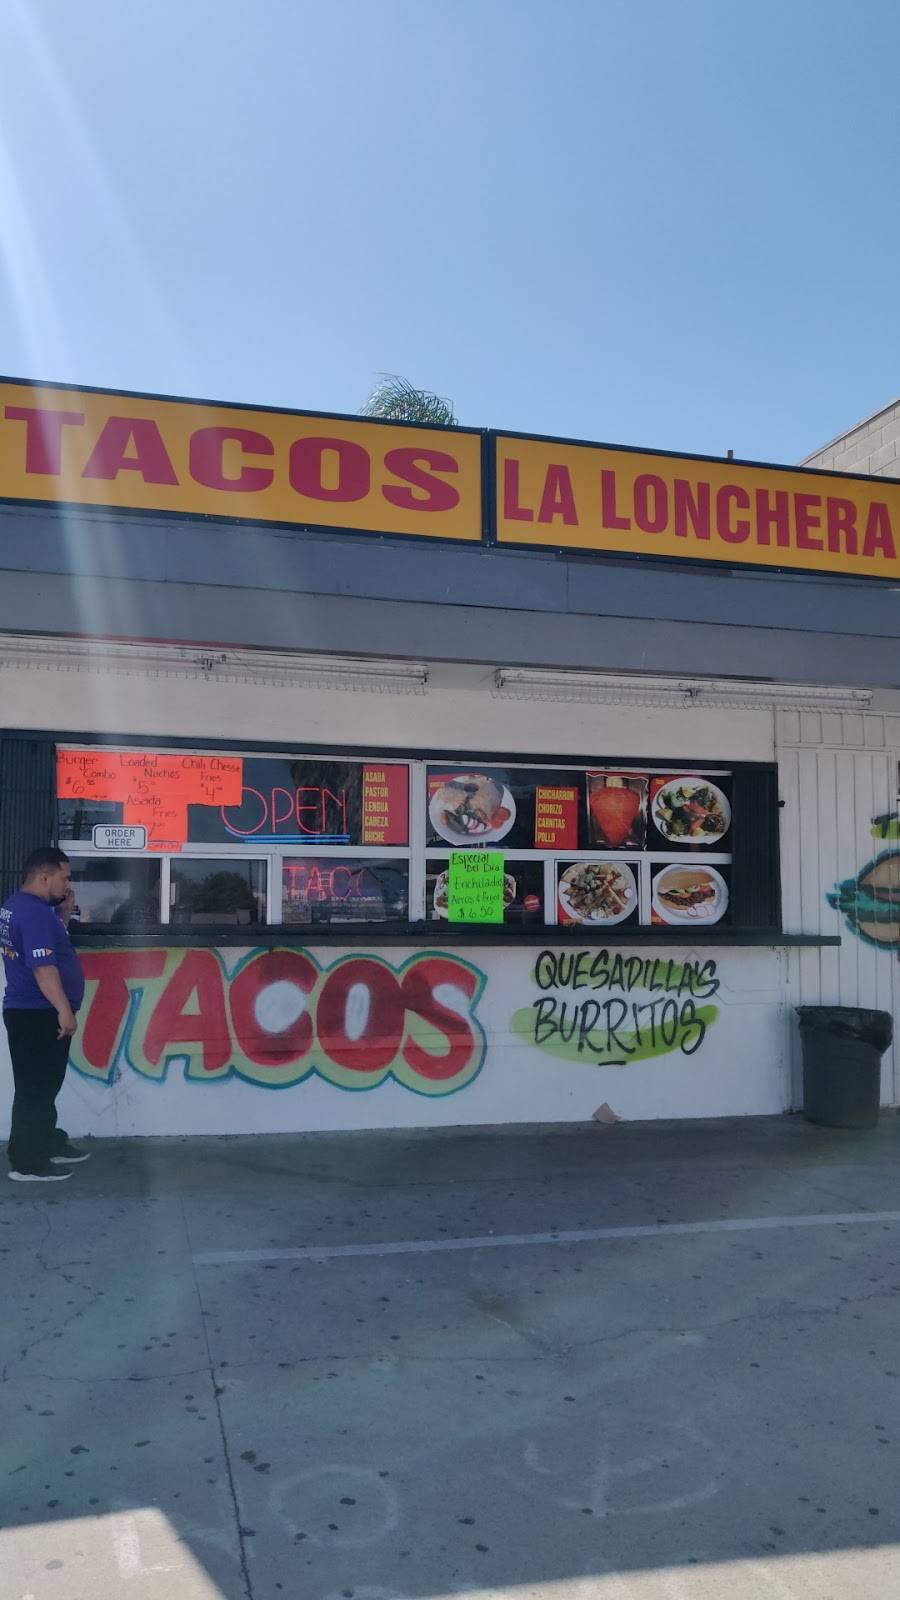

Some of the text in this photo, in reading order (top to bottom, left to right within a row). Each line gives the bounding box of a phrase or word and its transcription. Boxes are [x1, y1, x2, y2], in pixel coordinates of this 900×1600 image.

[5, 405, 460, 512] TACOS
[503, 458, 898, 560] LA LONCHERA
[56, 752, 97, 771] Burger
[120, 754, 158, 768] Loaded
[182, 757, 206, 770] Chili
[83, 768, 116, 780] Combo
[144, 768, 180, 779] Nachos
[365, 771, 386, 783] ASADA
[365, 786, 389, 798] PASTOR
[538, 789, 575, 801] CHICHARRON
[127, 794, 161, 806] Asada
[221, 787, 347, 835] OPEN
[365, 801, 389, 813] LENGUA
[538, 803, 563, 815] CHORIZO
[365, 815, 389, 828] CABEZA
[538, 817, 566, 829] CARNITAS
[105, 829, 135, 839] ORDER
[365, 831, 385, 842] BUCHE
[538, 832, 556, 843] POLLO
[108, 838, 133, 847] HERE
[452, 853, 489, 870] Especial
[76, 947, 483, 1090] TACOS
[533, 997, 706, 1055] BURRITOS
